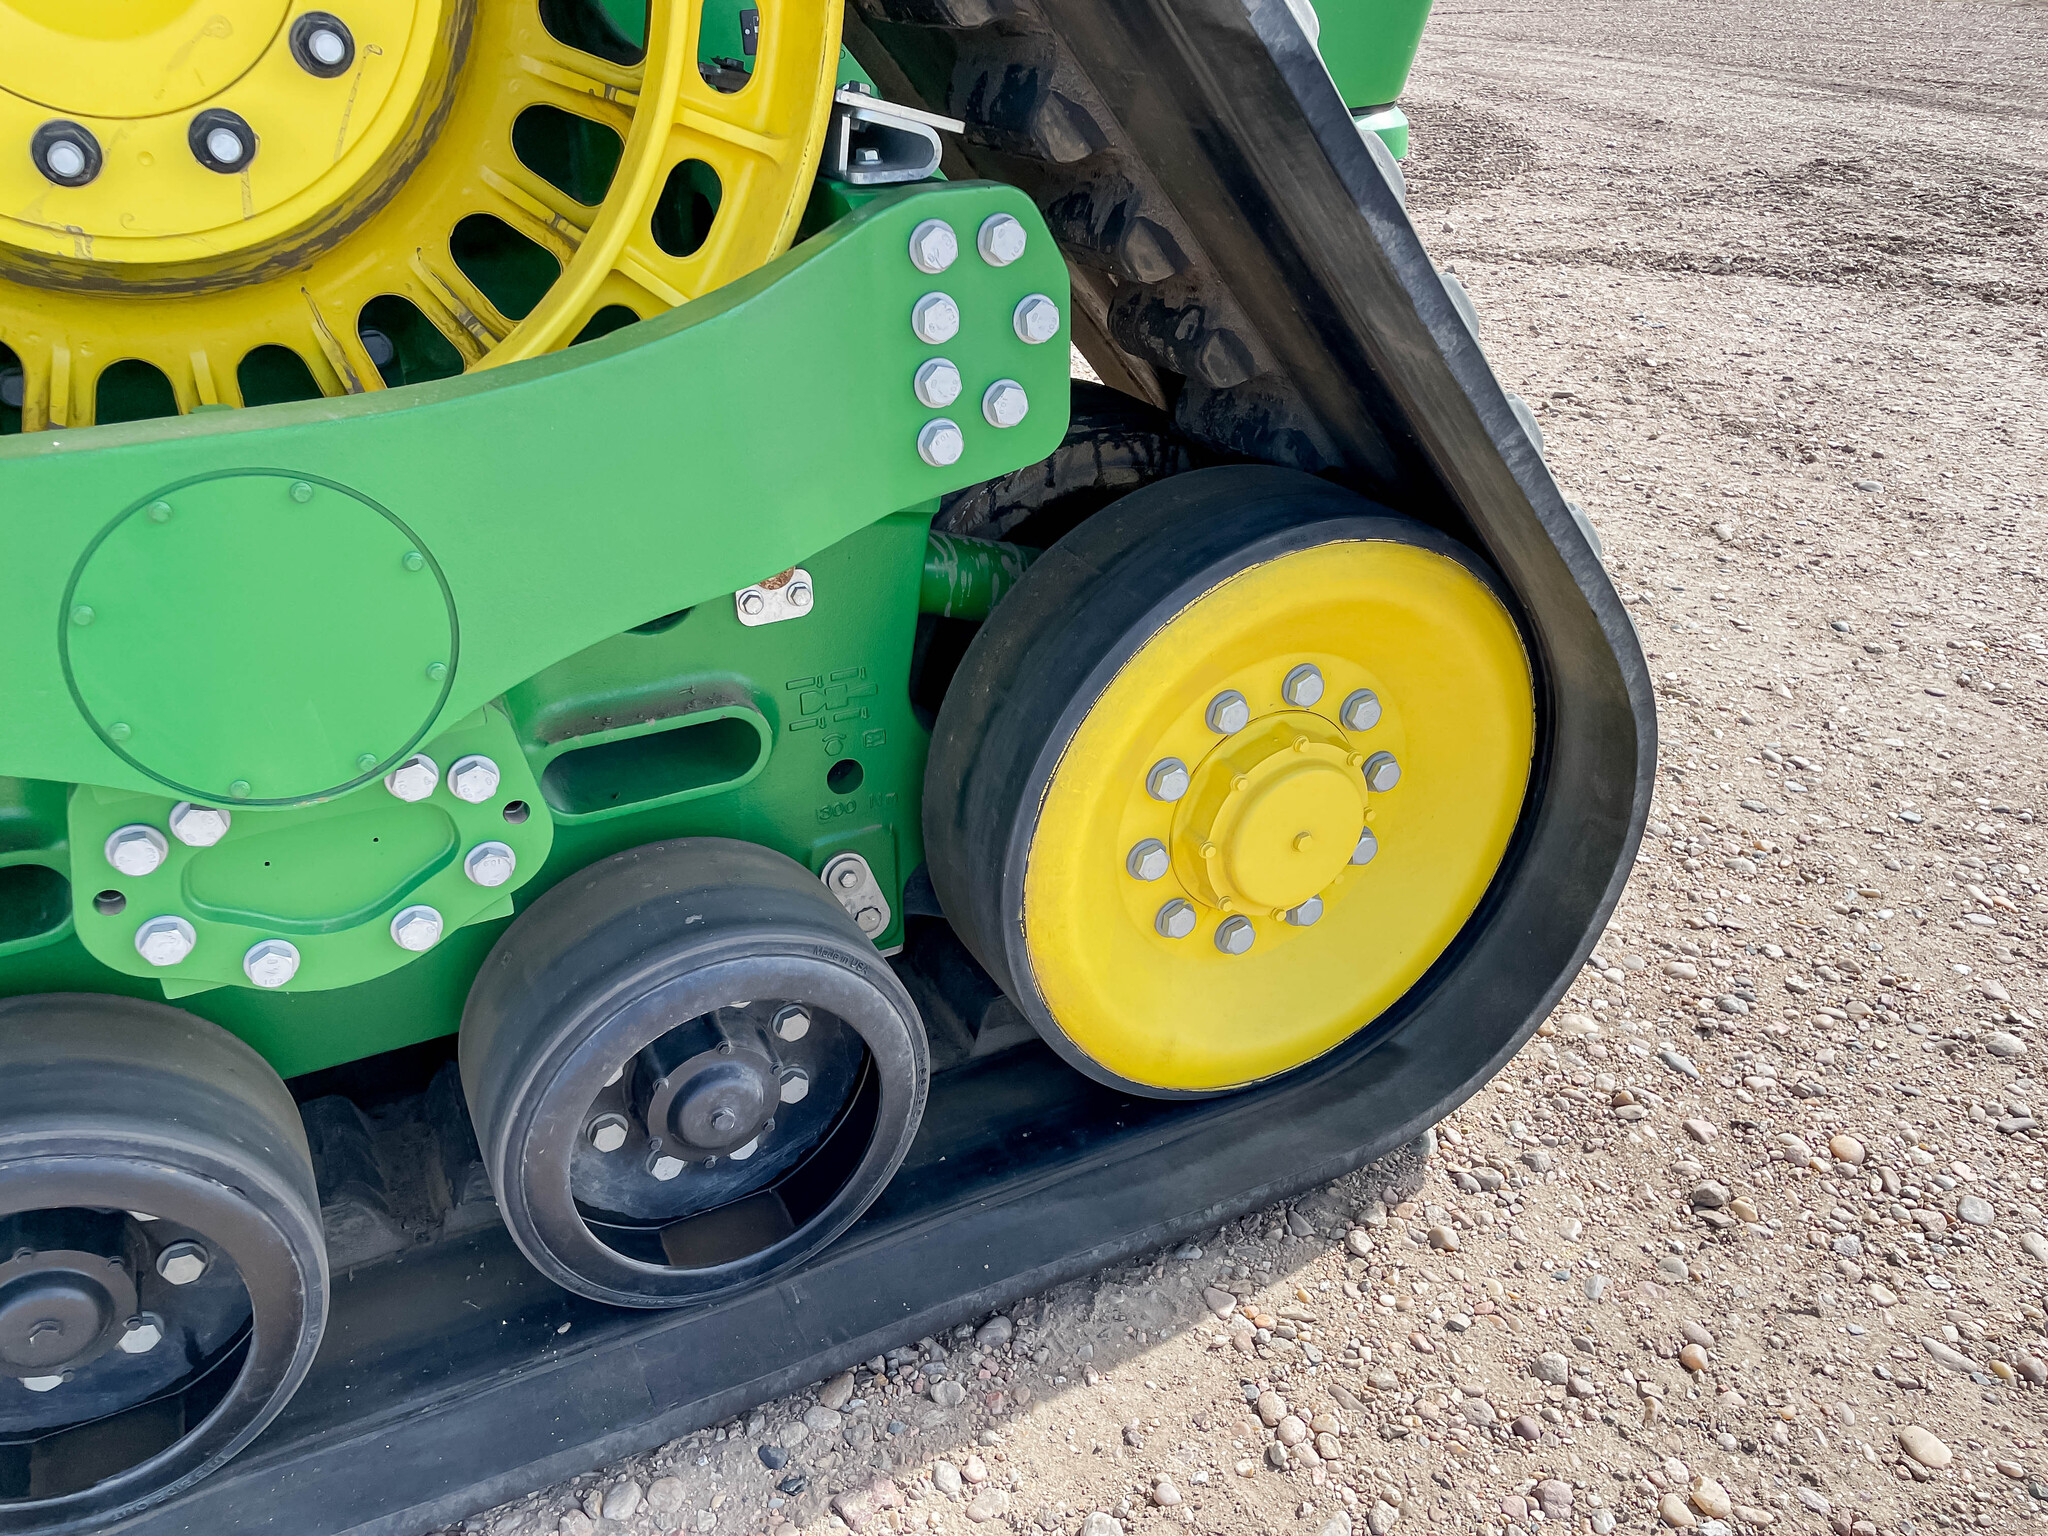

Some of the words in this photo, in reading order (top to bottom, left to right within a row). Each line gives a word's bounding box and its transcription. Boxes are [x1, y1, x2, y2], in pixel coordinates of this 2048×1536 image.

[818, 799, 857, 821] 300
[812, 944, 840, 961] Made
[840, 953, 850, 965] in
[850, 957, 870, 975] USA
[155, 1479, 192, 1504] SIDE
